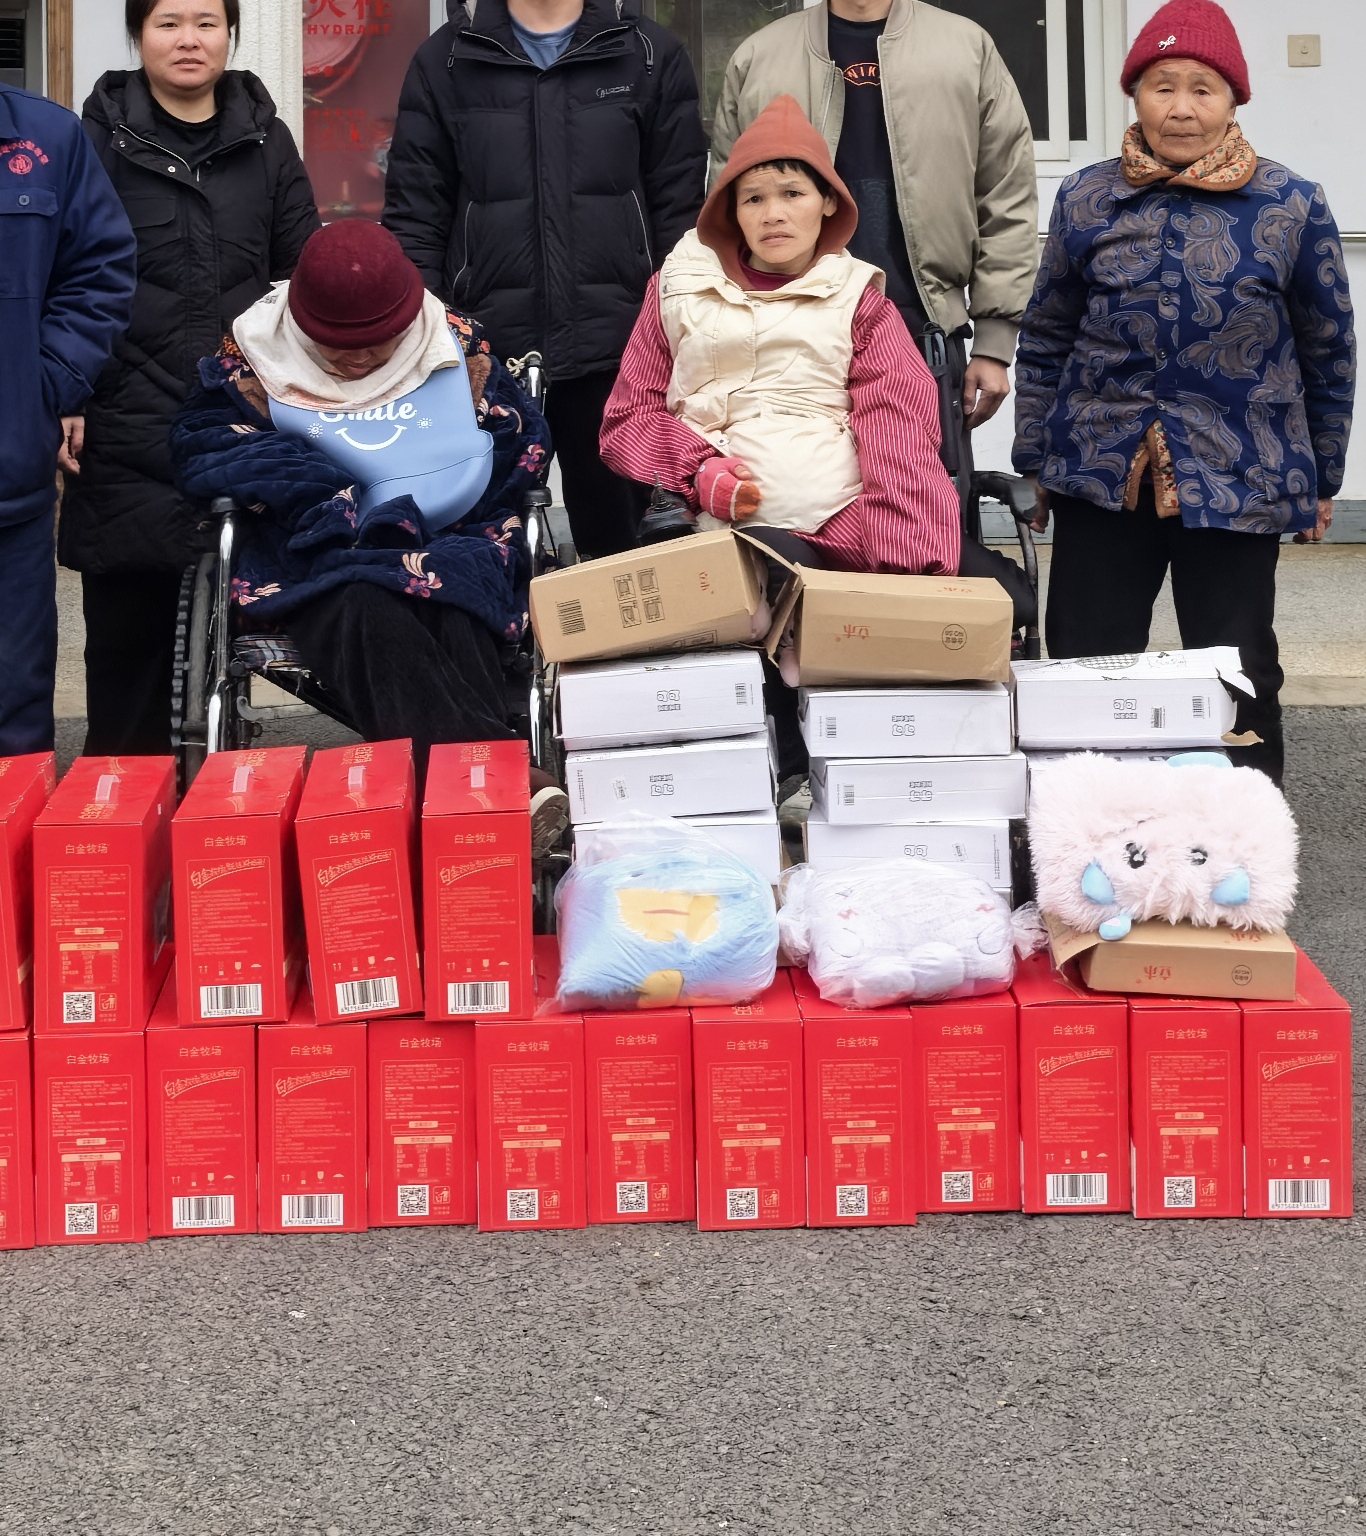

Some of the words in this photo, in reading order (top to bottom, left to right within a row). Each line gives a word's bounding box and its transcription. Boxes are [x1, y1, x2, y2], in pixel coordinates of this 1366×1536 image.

[307, 24, 391, 35] HYDRANT
[847, 66, 882, 80] NIK
[204, 835, 247, 848] 白金牧场
[328, 829, 371, 845] 白金牧场
[454, 832, 497, 844] 白金牧场
[65, 842, 108, 855] 白金牧场
[941, 1024, 984, 1036] 白金牧场
[1053, 1024, 1095, 1036] 白金牧场
[1165, 1028, 1208, 1040] 白金牧场
[1276, 1029, 1319, 1041] 白金牧场
[399, 1037, 442, 1049] 白金牧场
[615, 1033, 658, 1046] 白金牧场
[726, 1039, 769, 1051] 白金牧场
[836, 1036, 879, 1048] 白金牧场
[179, 1045, 222, 1058] 白金牧场
[290, 1044, 333, 1056] 白金牧场
[507, 1040, 550, 1052] 白金牧场
[66, 1053, 110, 1065] 白金牧场
